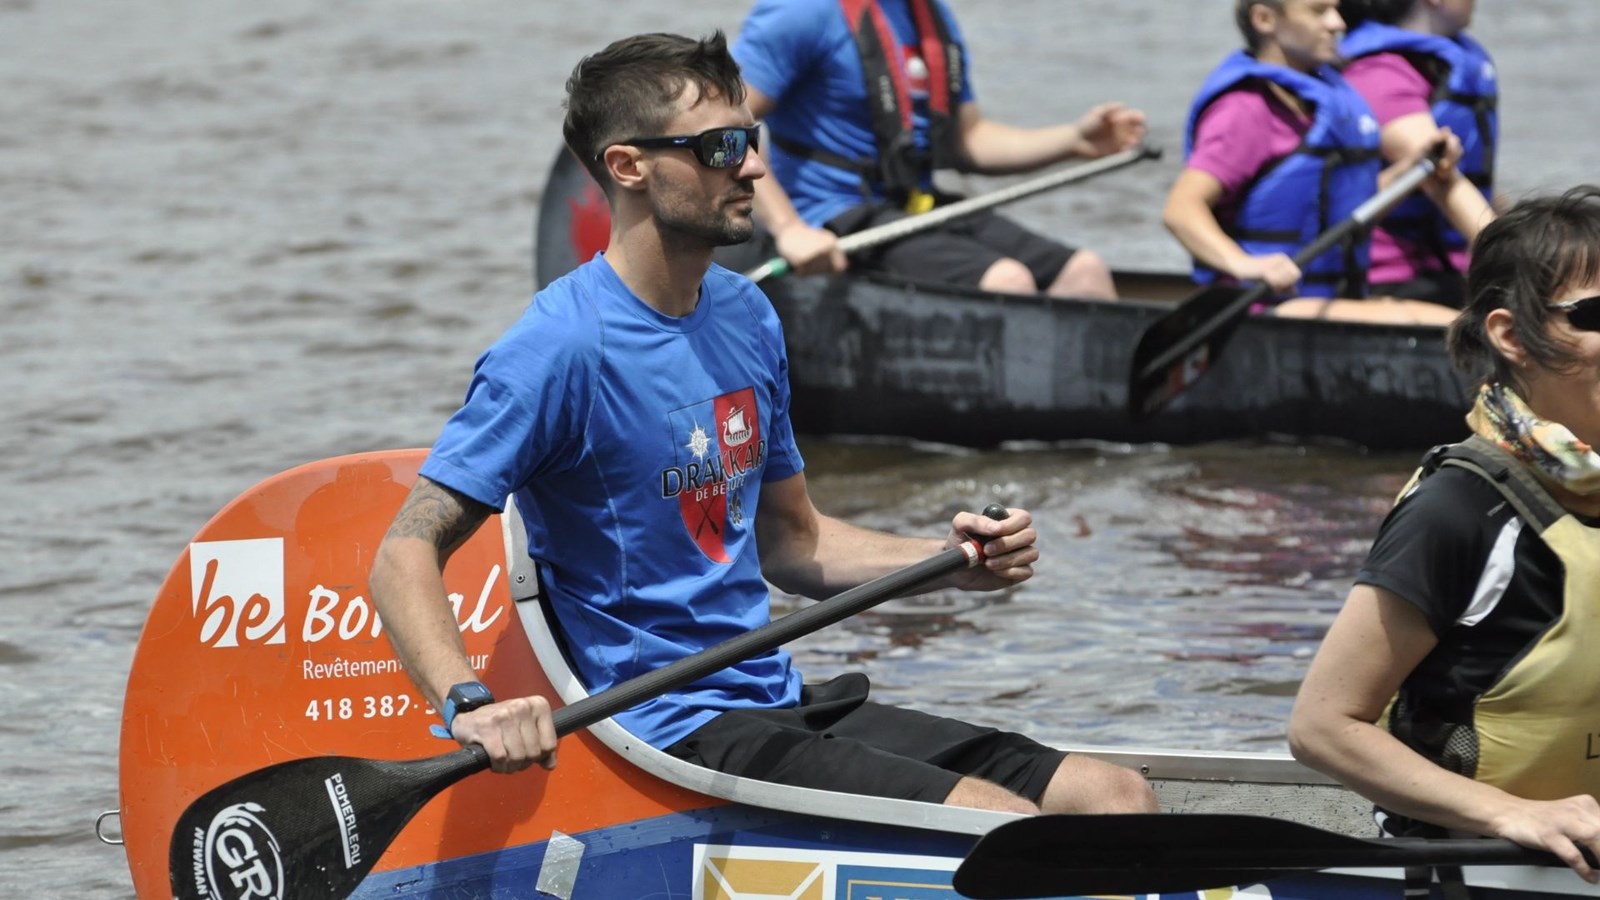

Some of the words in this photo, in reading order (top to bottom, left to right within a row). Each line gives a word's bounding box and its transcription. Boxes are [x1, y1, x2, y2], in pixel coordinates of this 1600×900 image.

[662, 440, 766, 499] DRAKKAR
[695, 488, 709, 502] DE
[305, 698, 353, 721] 418
[331, 772, 361, 865] POMERLEAU
[193, 826, 209, 895] NEWMAN
[216, 828, 278, 900] GR
